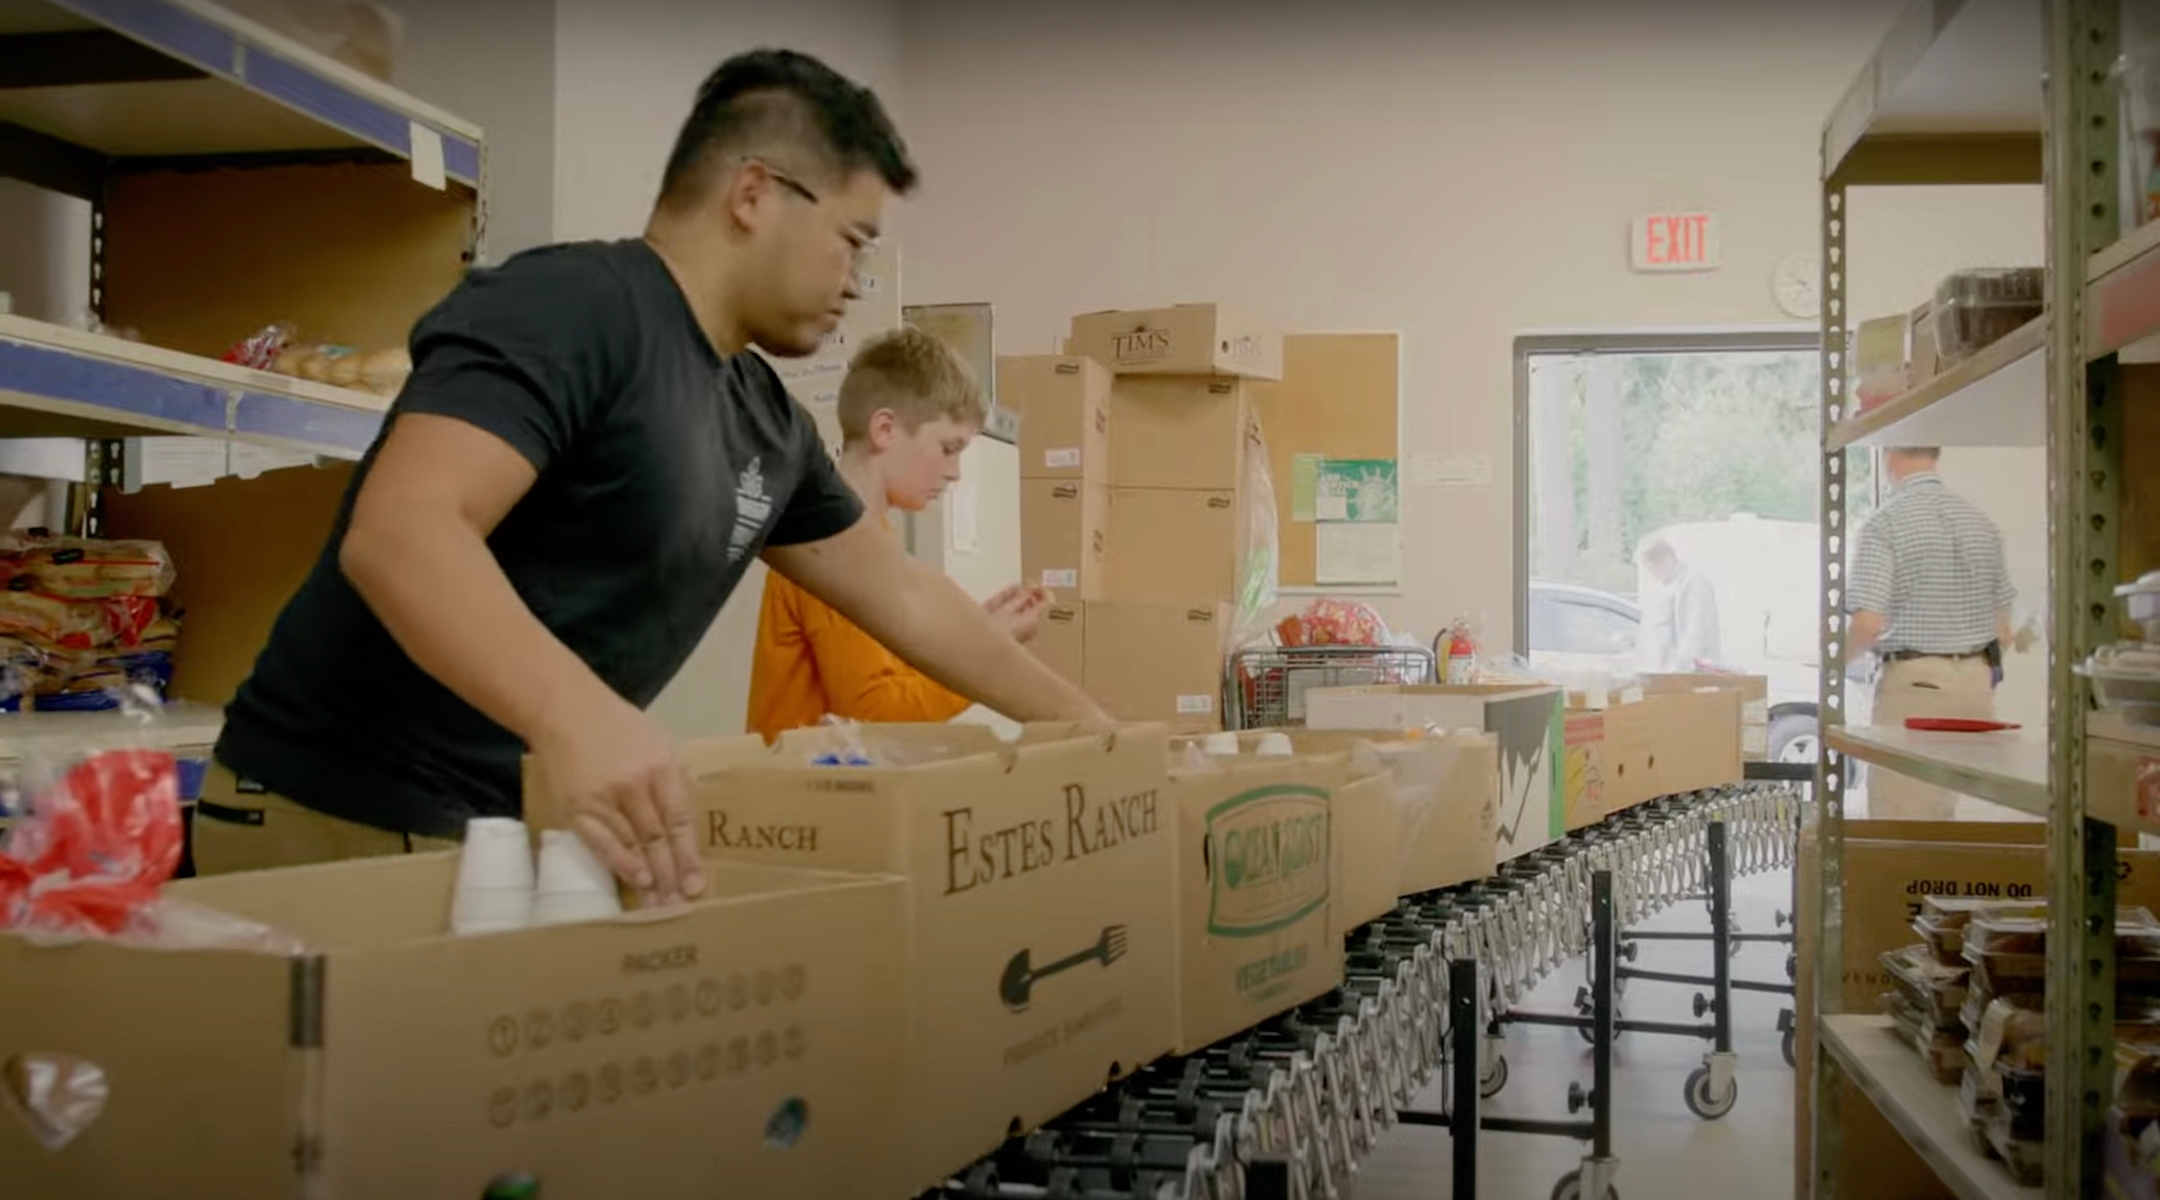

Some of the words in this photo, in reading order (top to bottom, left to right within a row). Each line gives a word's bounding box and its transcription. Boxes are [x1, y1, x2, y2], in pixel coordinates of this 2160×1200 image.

[1647, 215, 1708, 264] EXIT
[707, 809, 818, 851] RANCH
[942, 807, 1055, 897] ESTES
[1062, 782, 1158, 862] RANCH
[1906, 879, 1958, 896] DROP
[1964, 881, 2000, 898] NOT
[2007, 882, 2033, 898] DO
